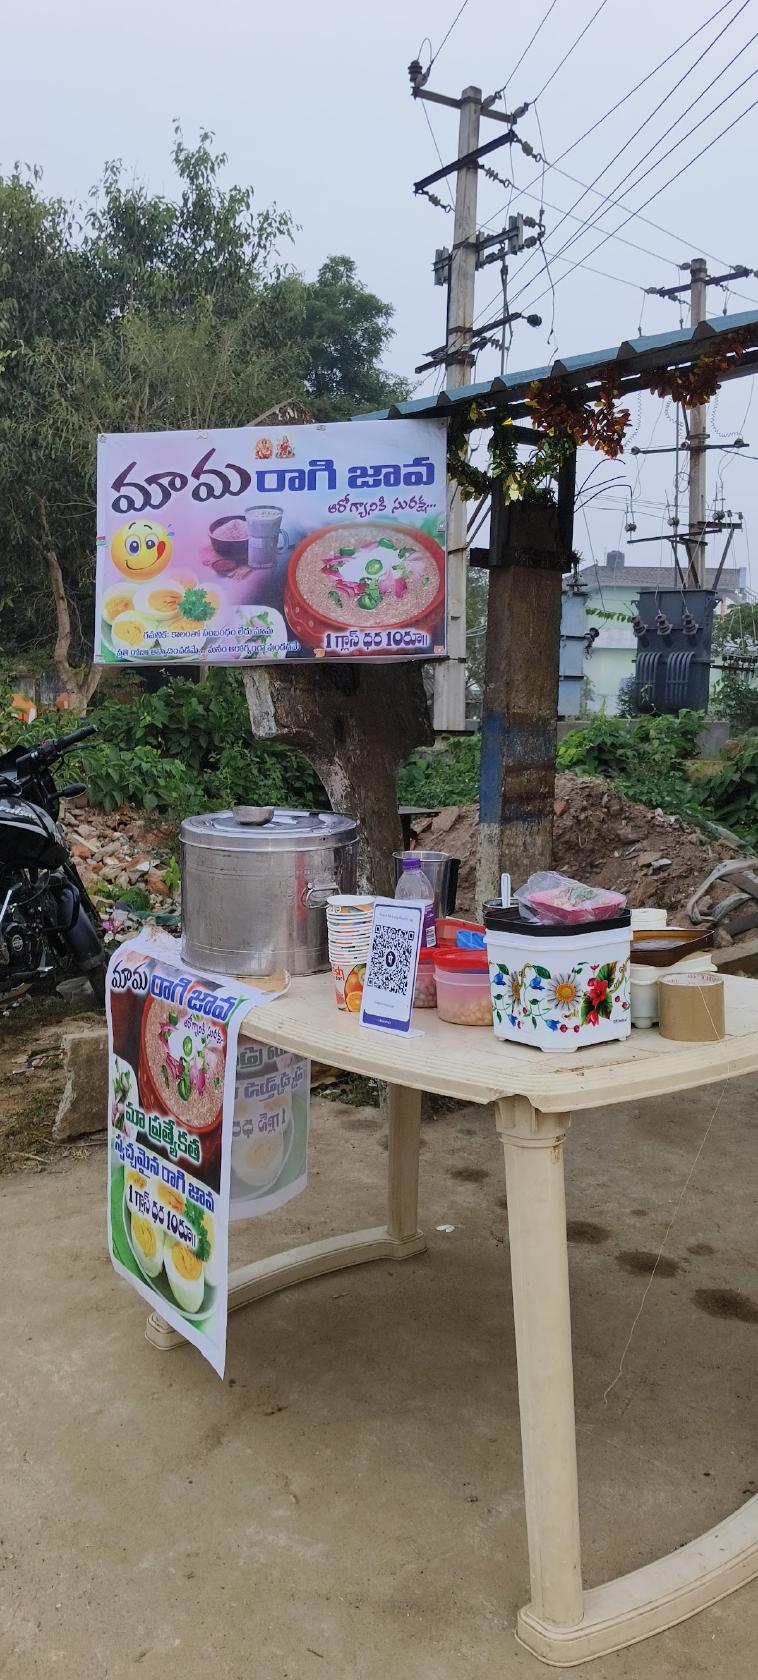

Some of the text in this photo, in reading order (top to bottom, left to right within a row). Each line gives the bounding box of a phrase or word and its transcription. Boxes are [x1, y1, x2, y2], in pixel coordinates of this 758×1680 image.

[111, 447, 435, 514] మామ రాగి జావ
[328, 493, 387, 518] ఆరోగ్యానికి
[325, 633, 332, 648] 1
[334, 630, 360, 652] గ్లాస్
[363, 632, 383, 651] ధర
[111, 960, 236, 1021] మామ రాగి జావ
[126, 1102, 200, 1163] మా ప్రత్యేకత
[129, 1184, 134, 1204] 1
[134, 1191, 150, 1215] గ్లాస్
[152, 1200, 165, 1224] ధర
[162, 1164, 186, 1194] రాగి
[188, 1182, 215, 1213] జావ
